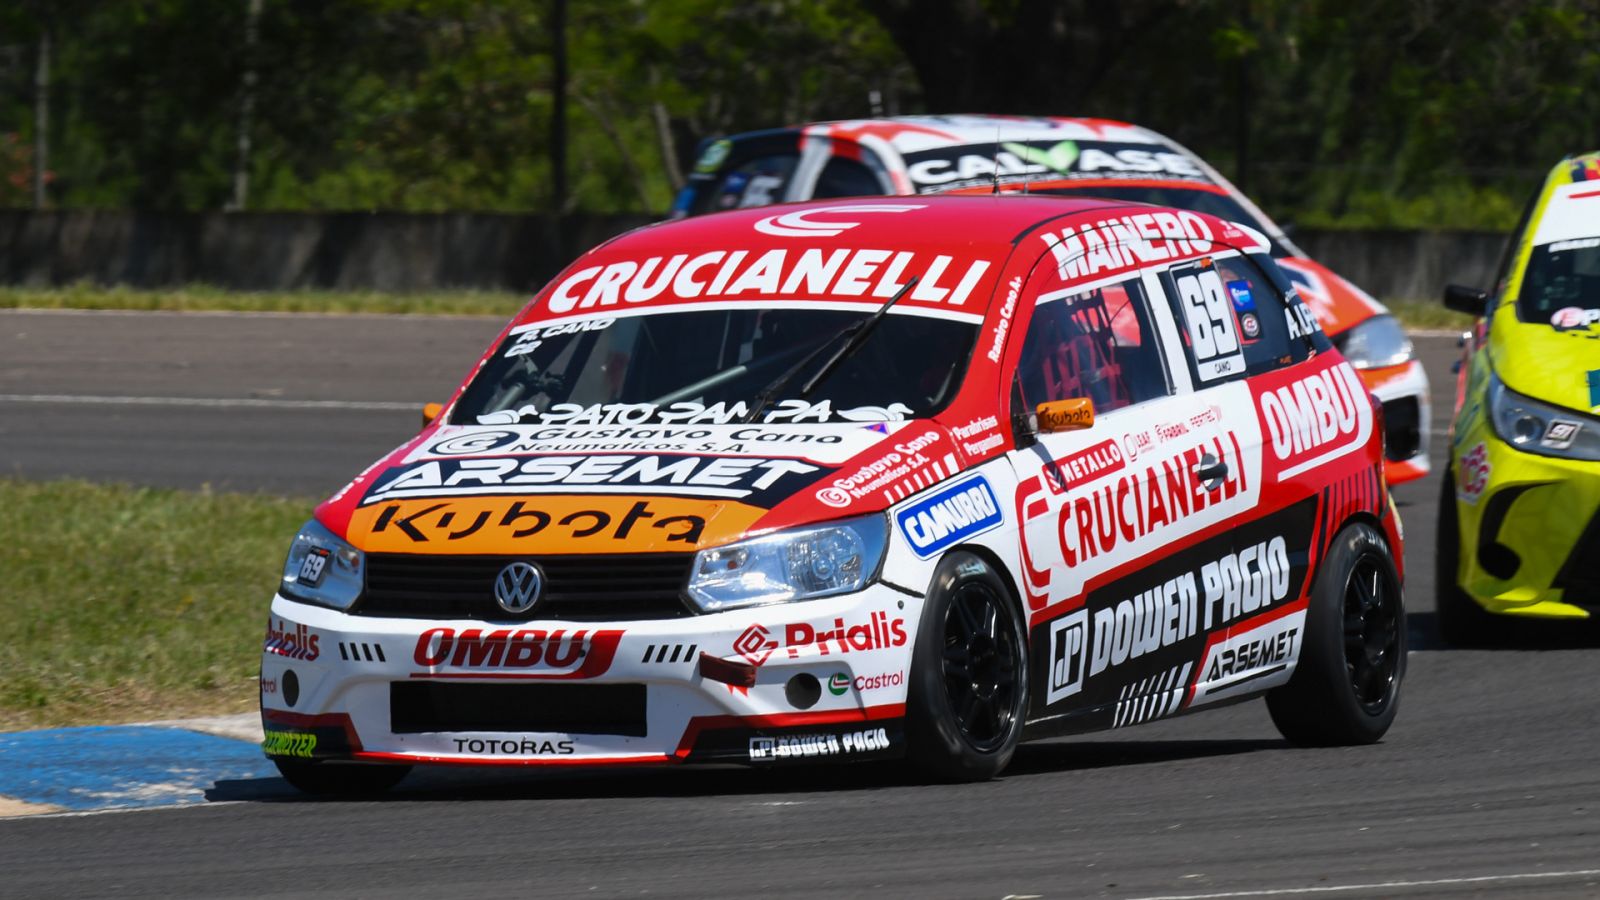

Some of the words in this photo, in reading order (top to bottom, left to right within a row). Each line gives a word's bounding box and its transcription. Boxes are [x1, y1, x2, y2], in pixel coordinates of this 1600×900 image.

[1041, 211, 1214, 281] MAINERO
[548, 249, 990, 313] CRUCIANELLI
[541, 318, 616, 338] CANO
[987, 318, 1008, 363] Ramiro
[1000, 289, 1017, 319] Cano
[1177, 271, 1238, 360] 69
[1214, 363, 1231, 374] CANO
[540, 403, 659, 425] PATO
[1047, 407, 1090, 425] Kubota
[1260, 362, 1357, 460] OMBU
[529, 427, 712, 440] Gustavo
[729, 428, 843, 443] Cano
[697, 442, 750, 453] S.A.
[375, 456, 820, 493] ARSEMET
[833, 453, 901, 490] Gustavo
[894, 431, 940, 454] Cano
[908, 453, 930, 469] S.A.
[1060, 443, 1122, 483] METALLO
[372, 501, 706, 542] Kubota
[904, 483, 997, 548] CAMURRI
[300, 553, 325, 581] 69
[413, 628, 596, 668] OMBU
[785, 611, 907, 658] Prialis
[1207, 627, 1298, 682] ARSEMET
[854, 670, 904, 691] Castrol
[453, 739, 574, 754] TOTORAS
